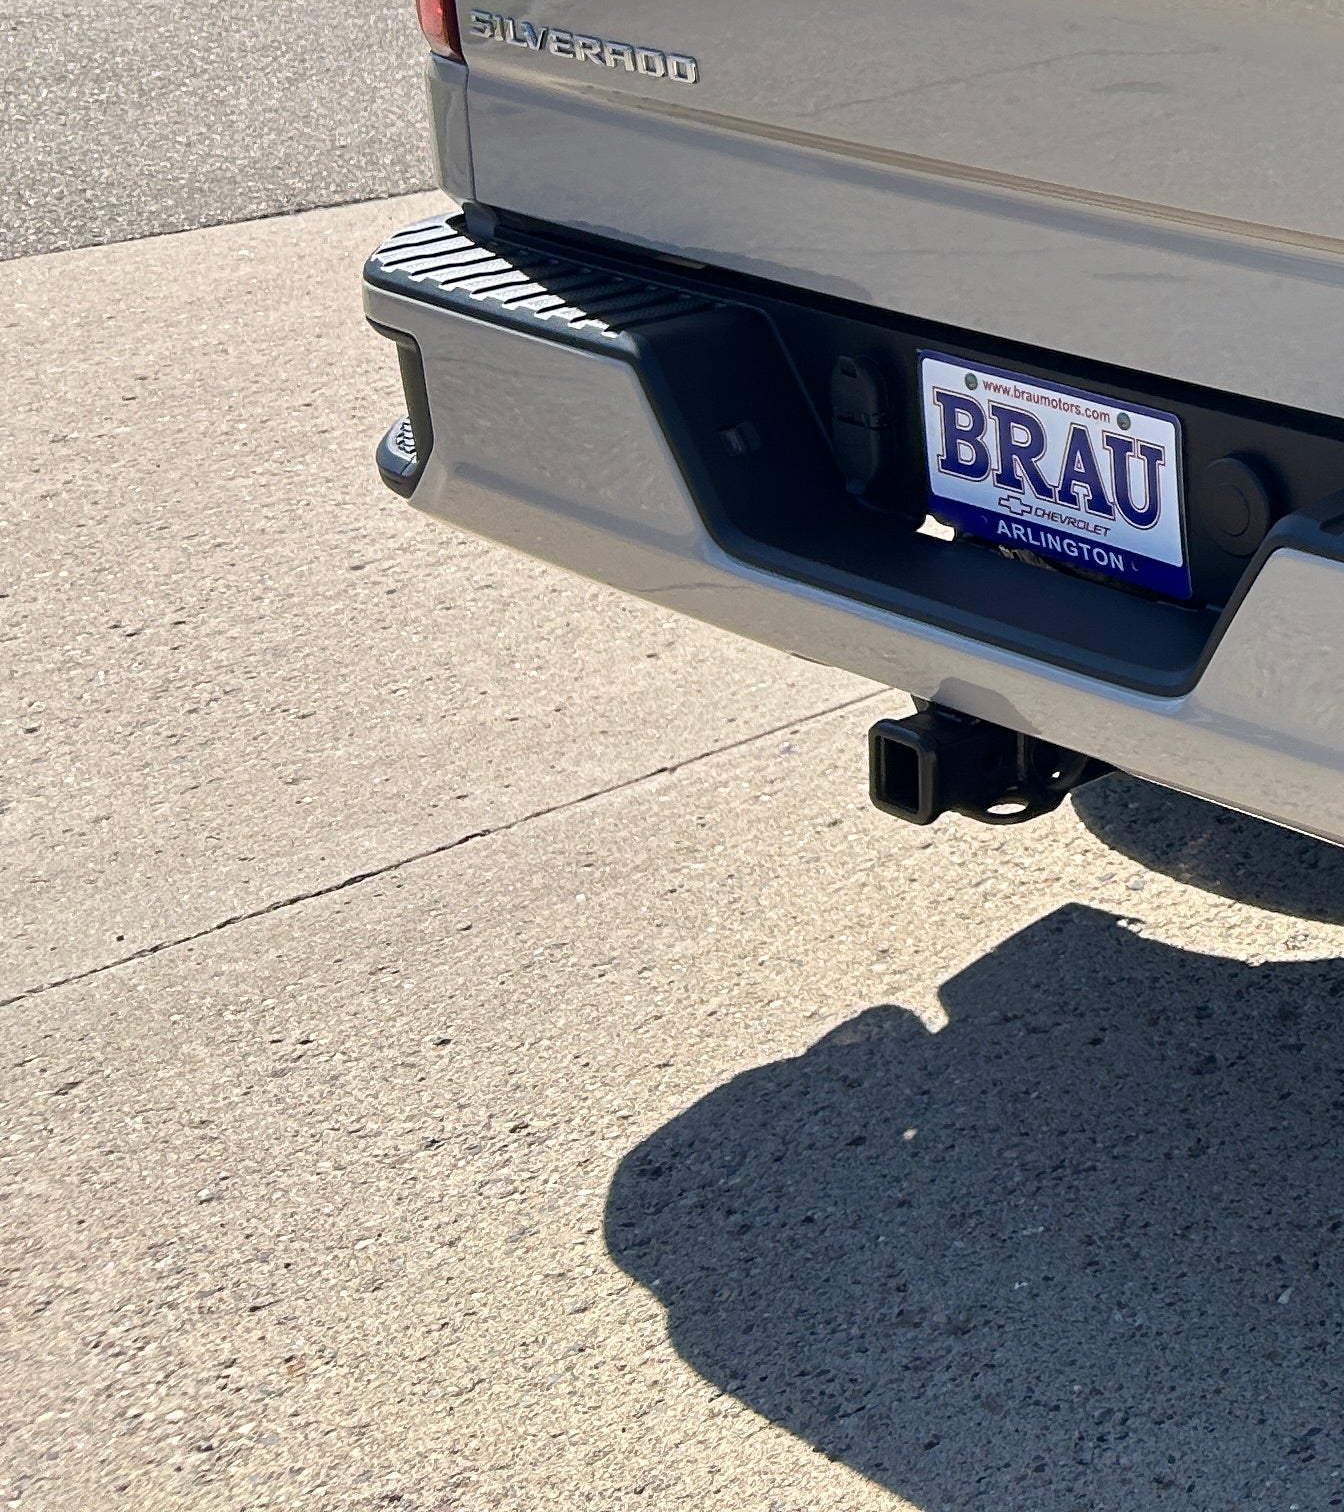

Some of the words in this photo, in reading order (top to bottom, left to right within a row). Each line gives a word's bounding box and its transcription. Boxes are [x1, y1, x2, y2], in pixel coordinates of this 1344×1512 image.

[470, 9, 700, 84] SILVERADO
[982, 378, 1111, 424] www.braumotors.com
[932, 386, 1166, 530] BRAU
[996, 519, 1125, 572] ARLINGTON
[1033, 507, 1112, 538] CHEVROLET
